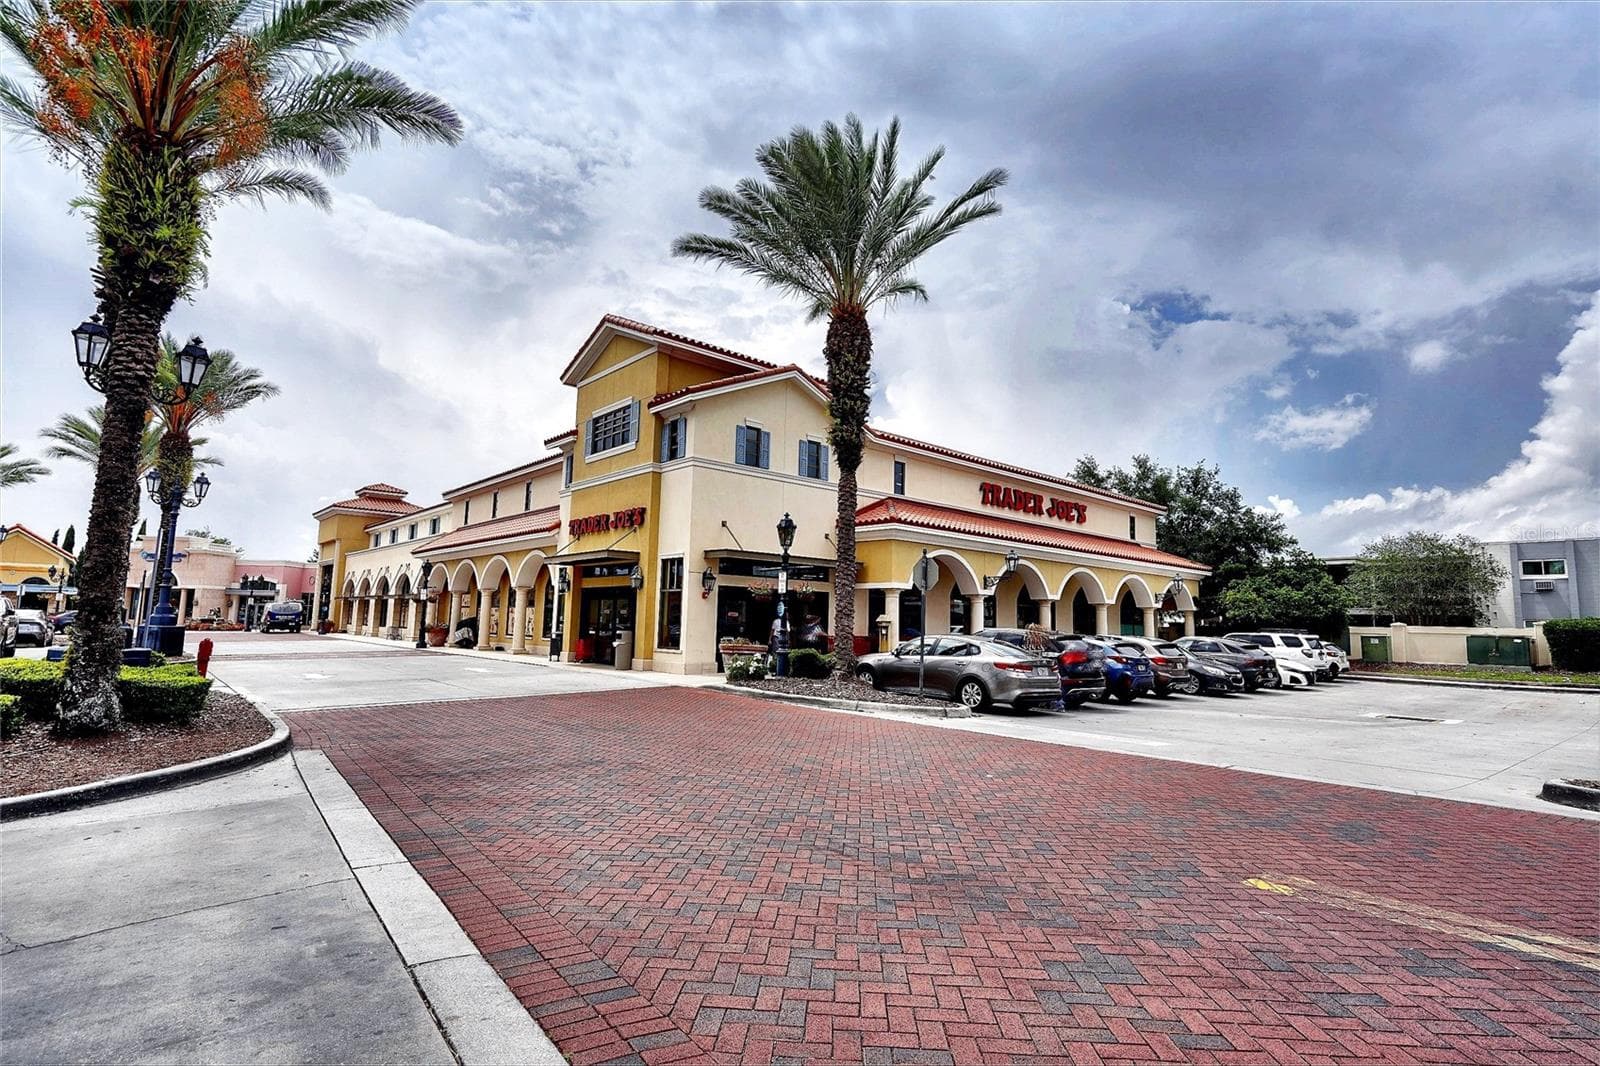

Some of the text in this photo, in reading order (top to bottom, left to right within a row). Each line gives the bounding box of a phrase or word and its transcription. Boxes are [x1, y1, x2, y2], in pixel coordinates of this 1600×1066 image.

[979, 482, 1087, 524] TRADER JOE'S
[569, 506, 646, 537] TRADER JOE'S
